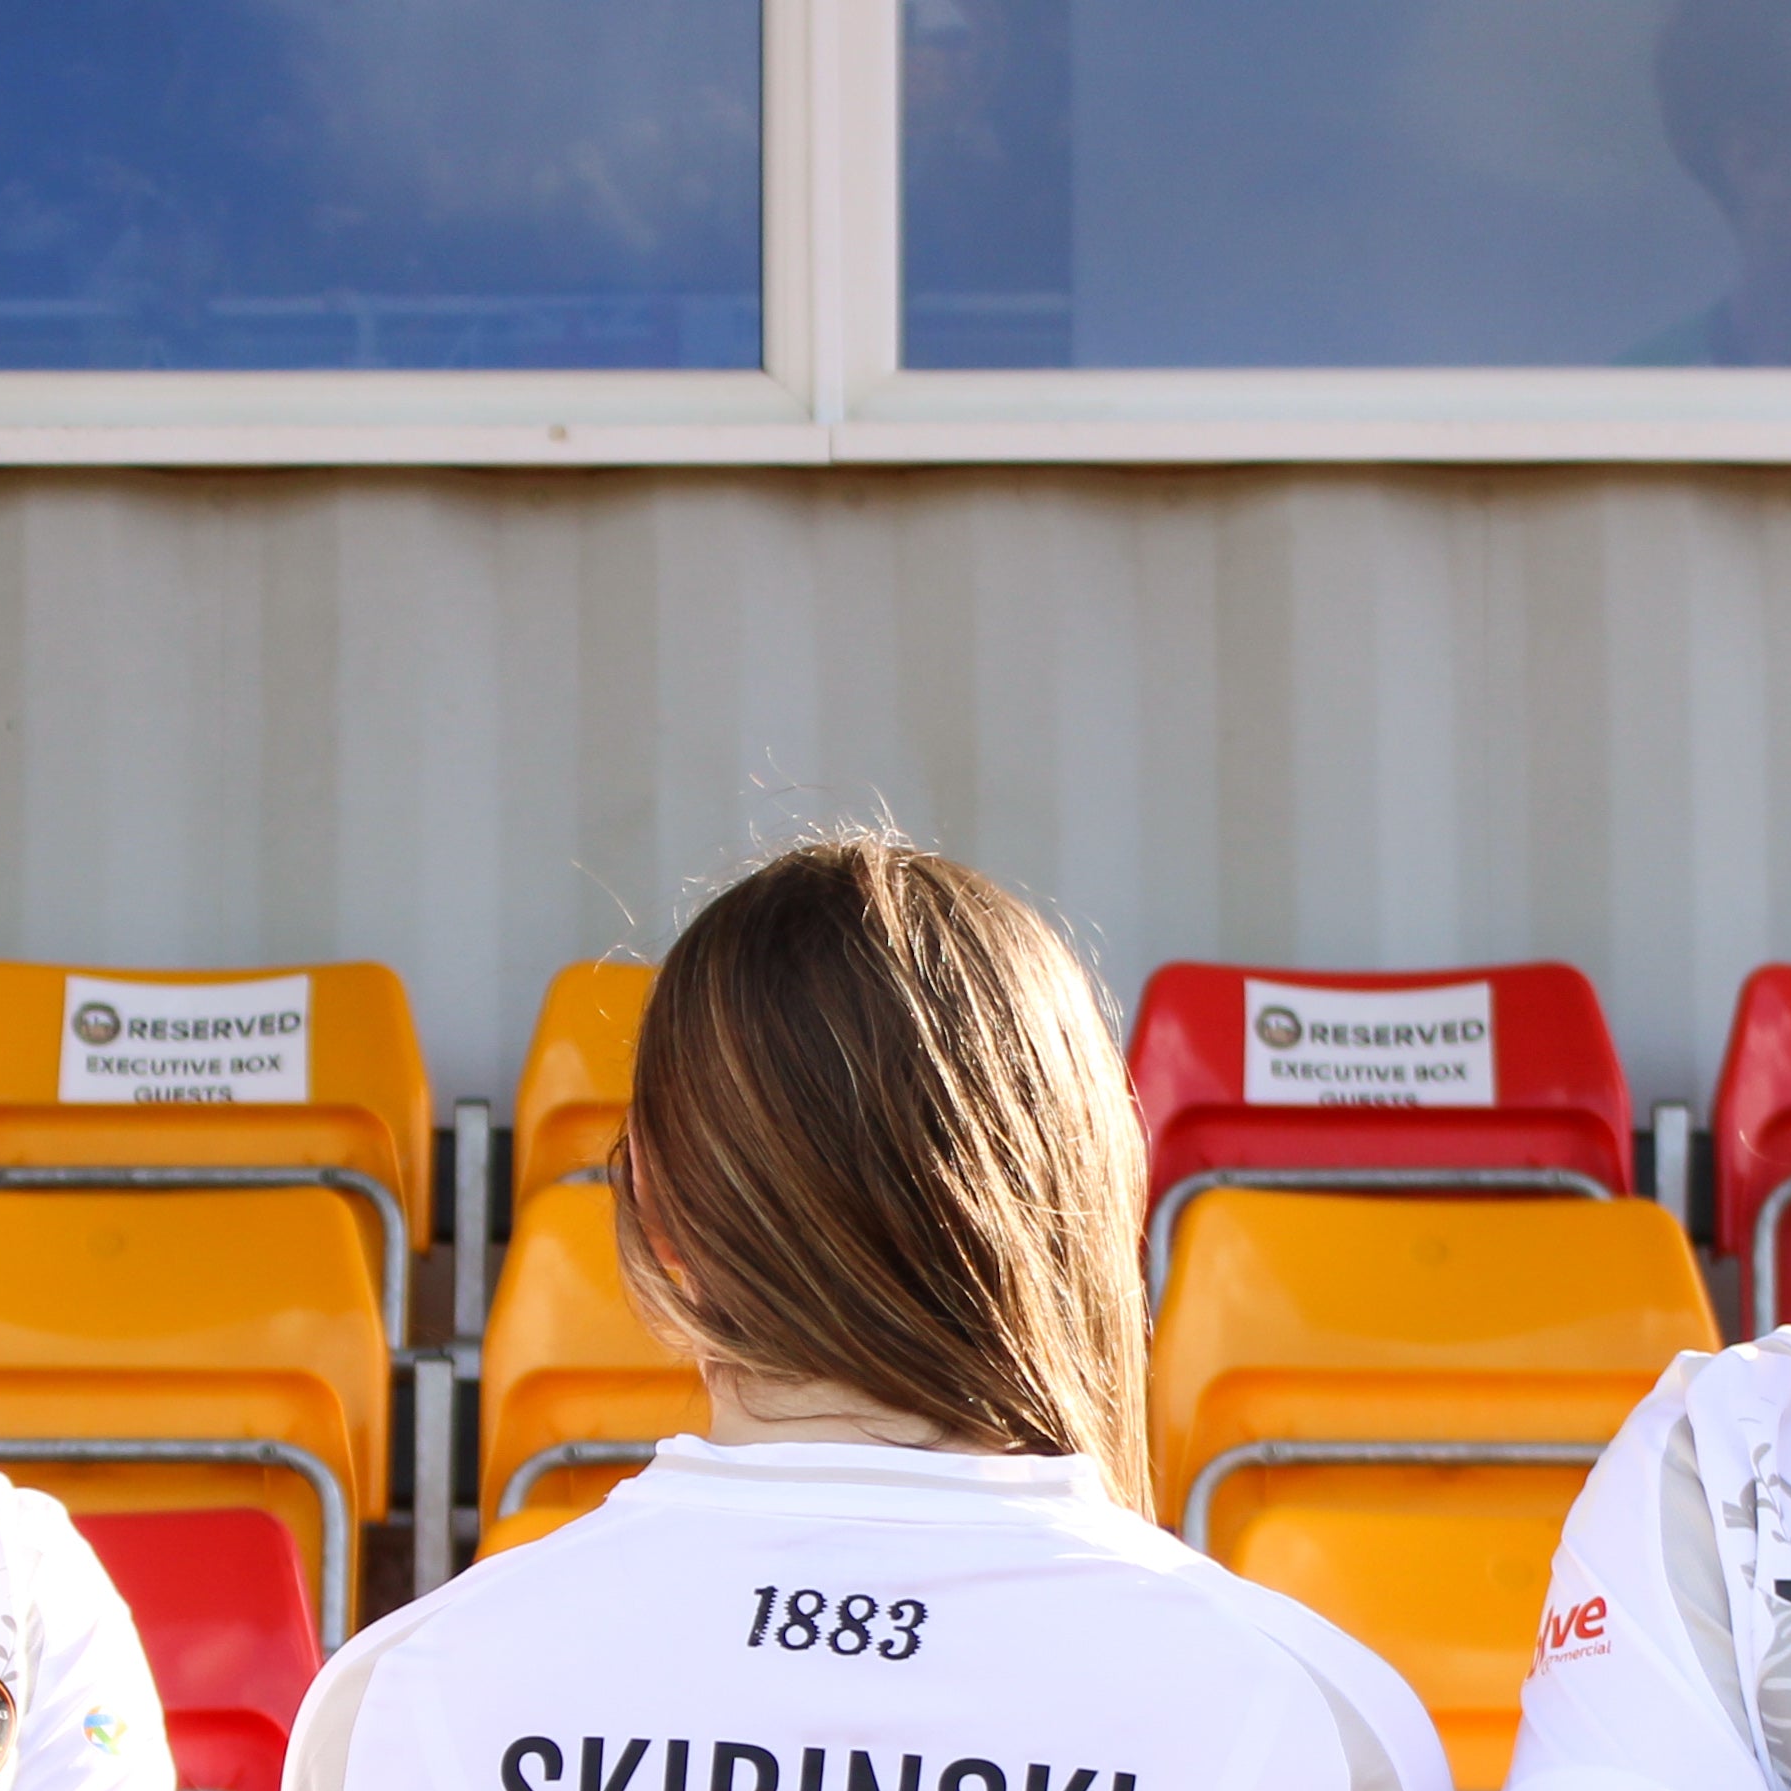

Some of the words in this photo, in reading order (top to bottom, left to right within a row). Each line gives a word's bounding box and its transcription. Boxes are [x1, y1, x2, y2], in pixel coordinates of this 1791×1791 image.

[127, 1012, 301, 1041] RESERVED
[1310, 1020, 1486, 1047] RESERVED
[86, 1055, 221, 1076] EXECUTIVE
[229, 1054, 281, 1075] BOX
[1270, 1060, 1406, 1082] EXECUTIVE
[1414, 1062, 1467, 1082] BOX
[746, 1585, 929, 1661] 1883
